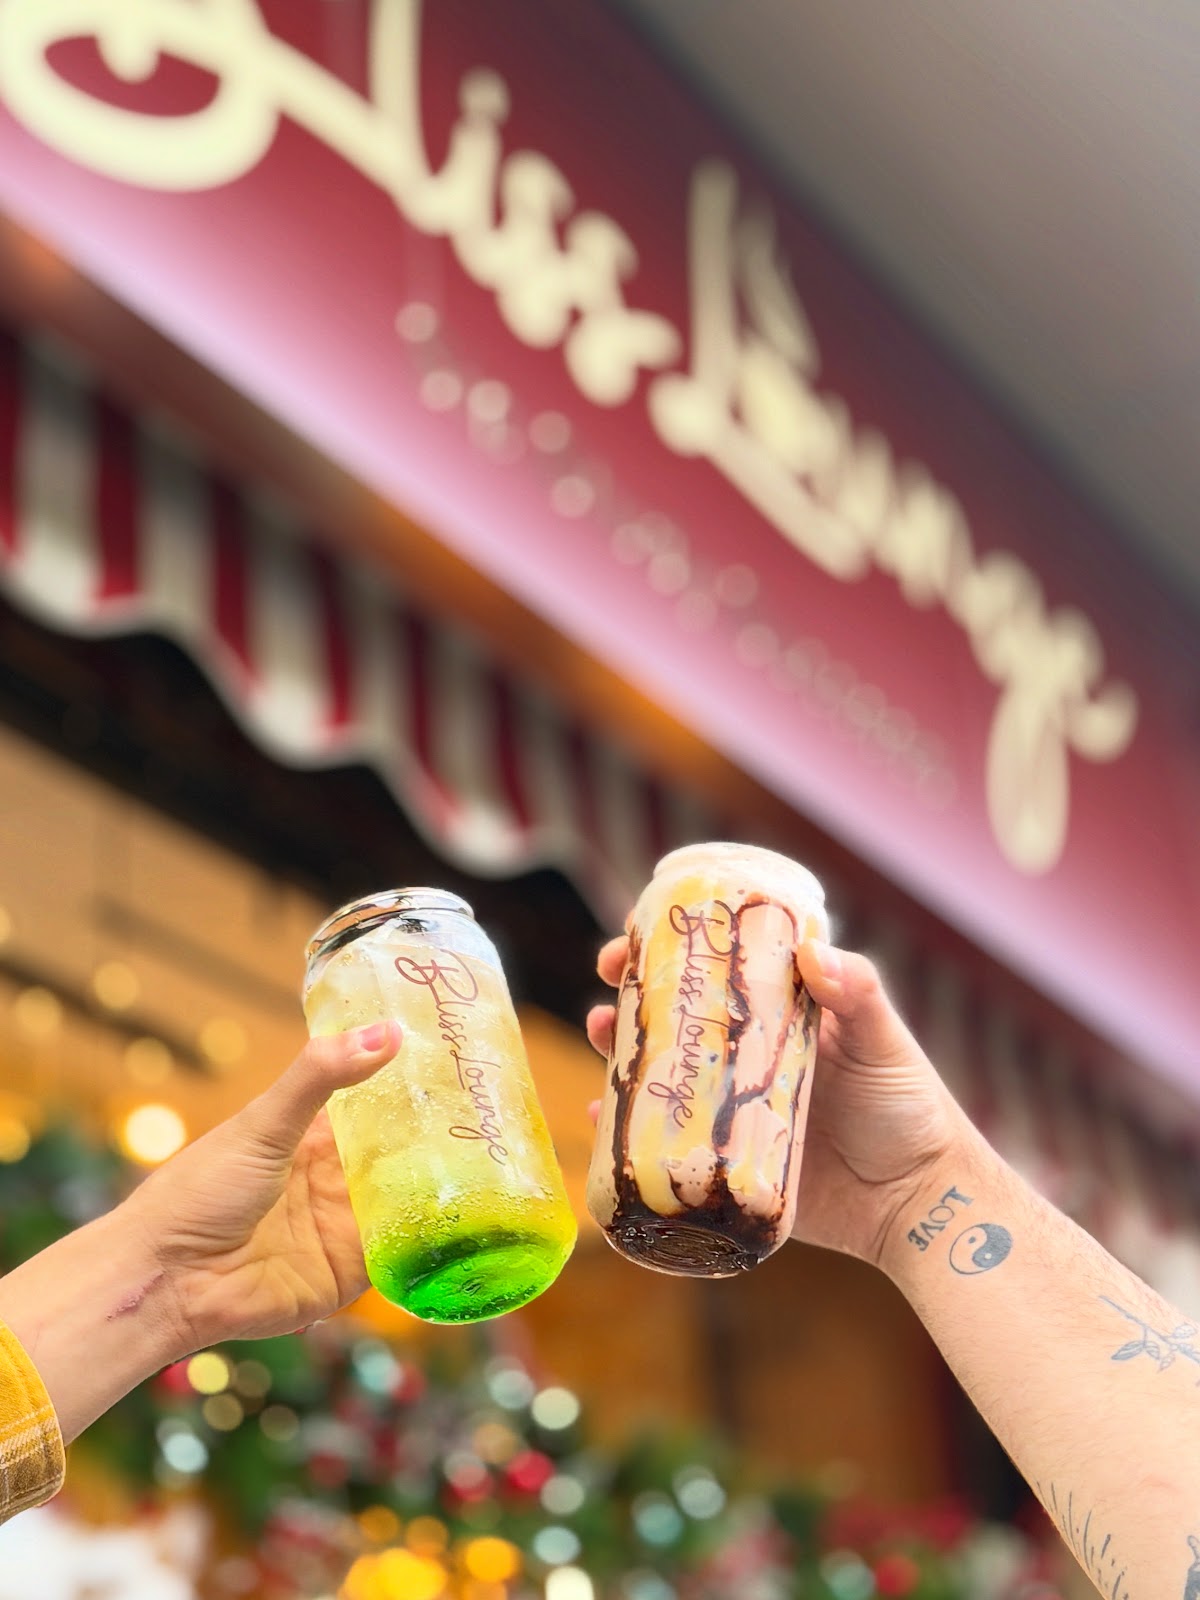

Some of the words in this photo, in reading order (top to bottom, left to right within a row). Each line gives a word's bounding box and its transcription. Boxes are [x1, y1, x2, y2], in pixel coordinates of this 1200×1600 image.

[670, 900, 737, 1005] Bliss
[394, 948, 479, 1050] Bliss
[448, 1049, 508, 1166] Lounge
[648, 1004, 730, 1129] Lounge
[907, 1185, 974, 1252] LOVE
